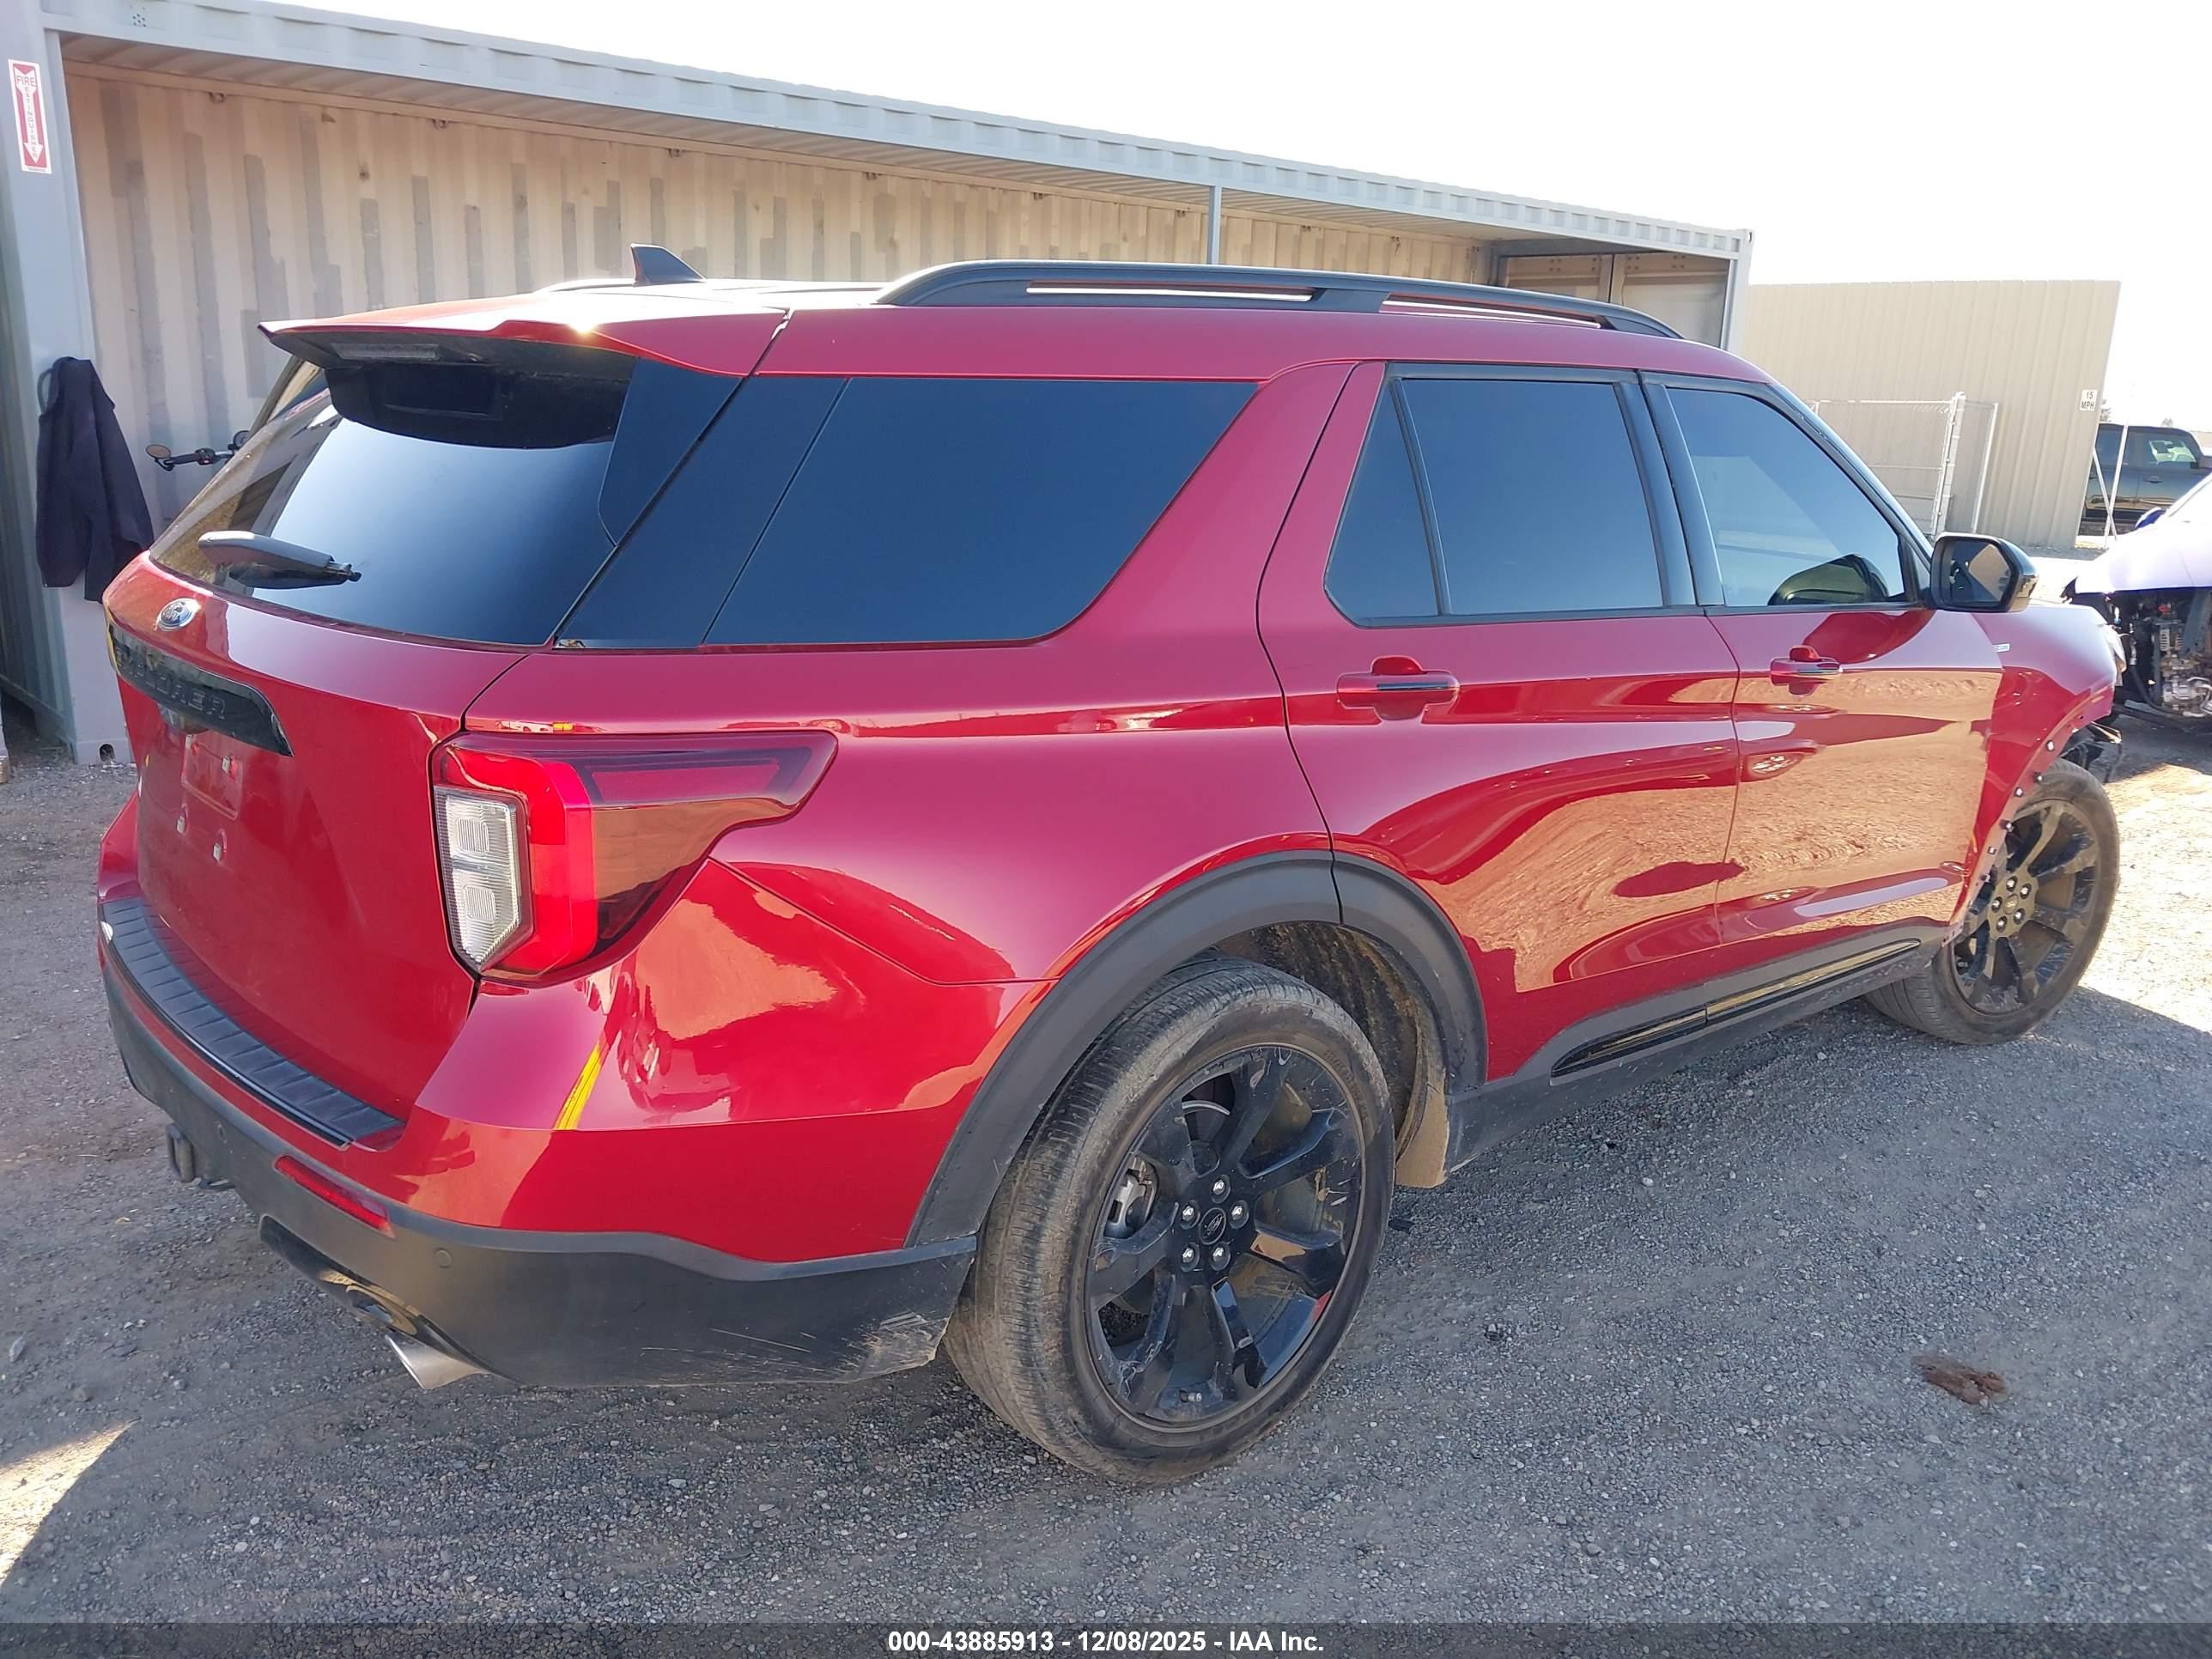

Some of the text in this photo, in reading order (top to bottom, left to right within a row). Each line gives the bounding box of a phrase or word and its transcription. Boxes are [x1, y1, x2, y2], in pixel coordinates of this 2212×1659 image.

[16, 76, 36, 87] FIRE
[2087, 391, 2094, 399] 15
[2081, 401, 2095, 410] MPH
